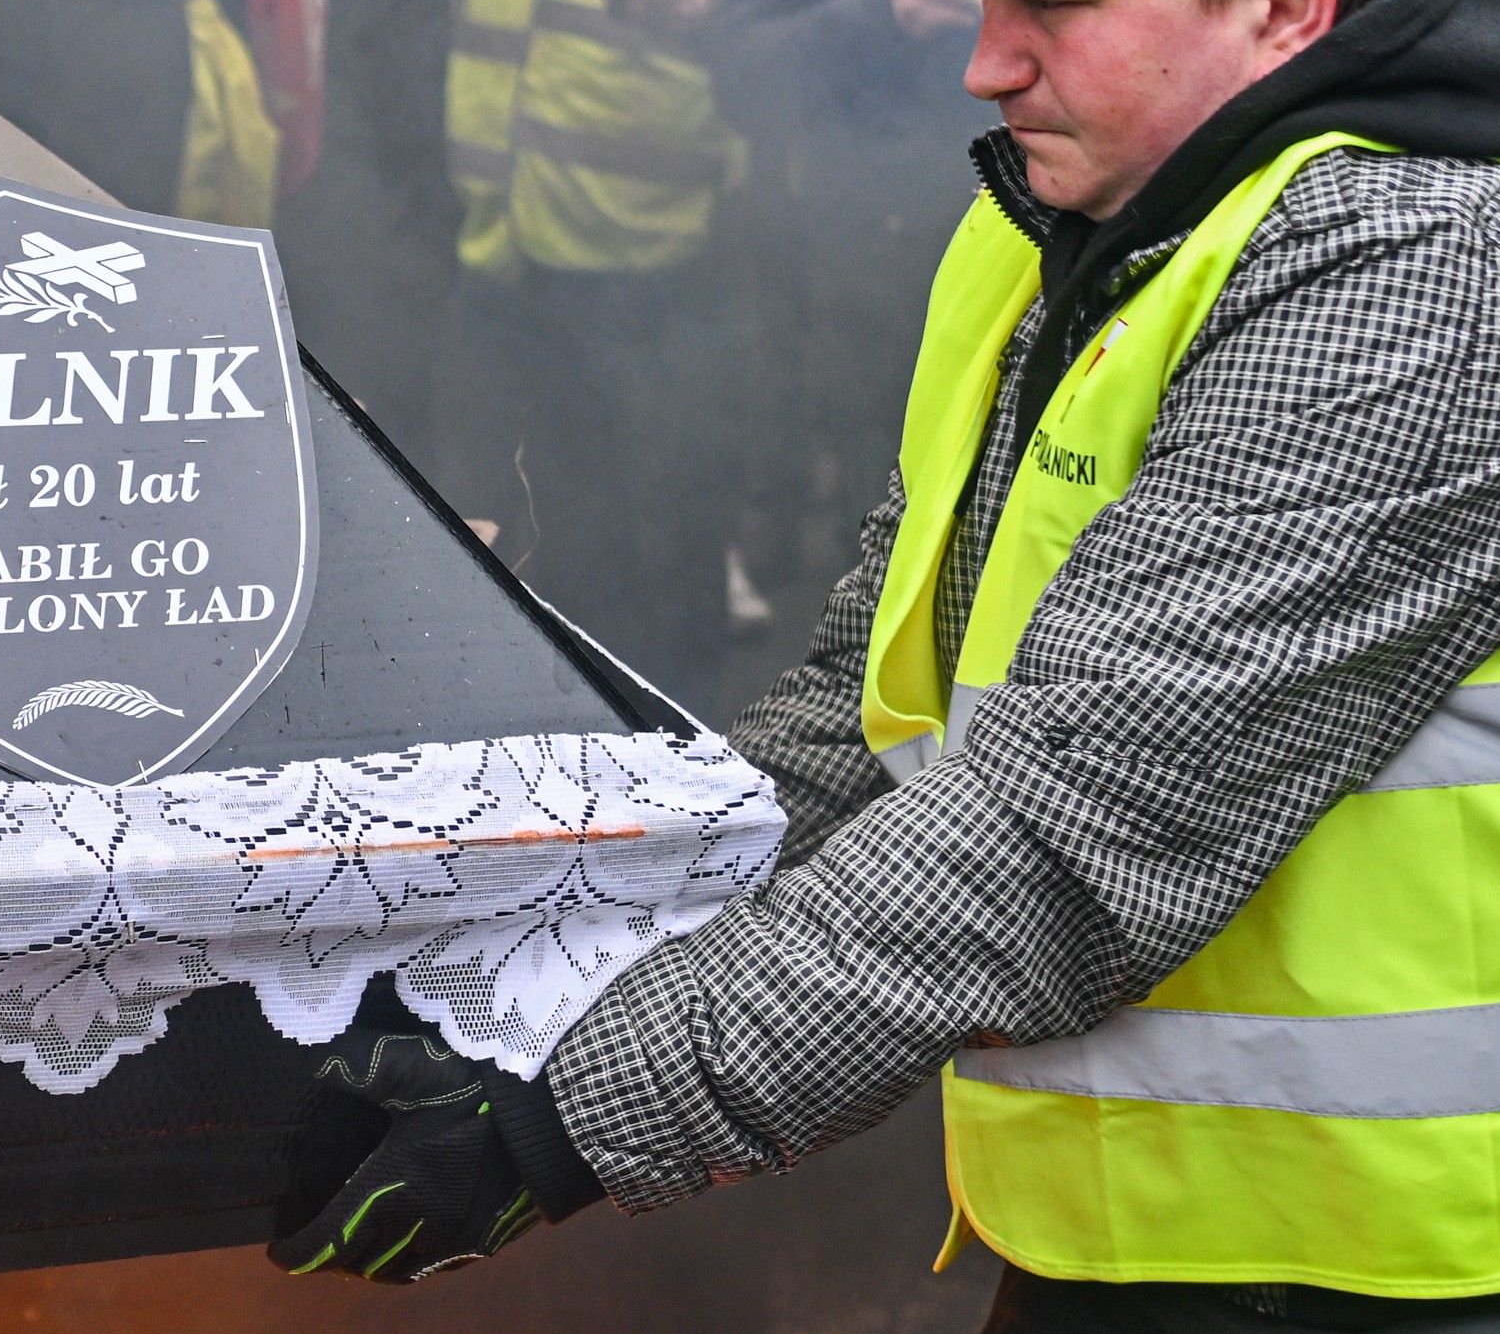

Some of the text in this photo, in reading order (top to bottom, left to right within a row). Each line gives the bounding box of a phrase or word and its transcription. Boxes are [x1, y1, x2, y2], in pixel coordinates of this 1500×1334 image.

[29, 463, 96, 508] 20
[117, 460, 201, 505] lat
[131, 538, 210, 578] GO
[164, 584, 275, 626] ŁAD
